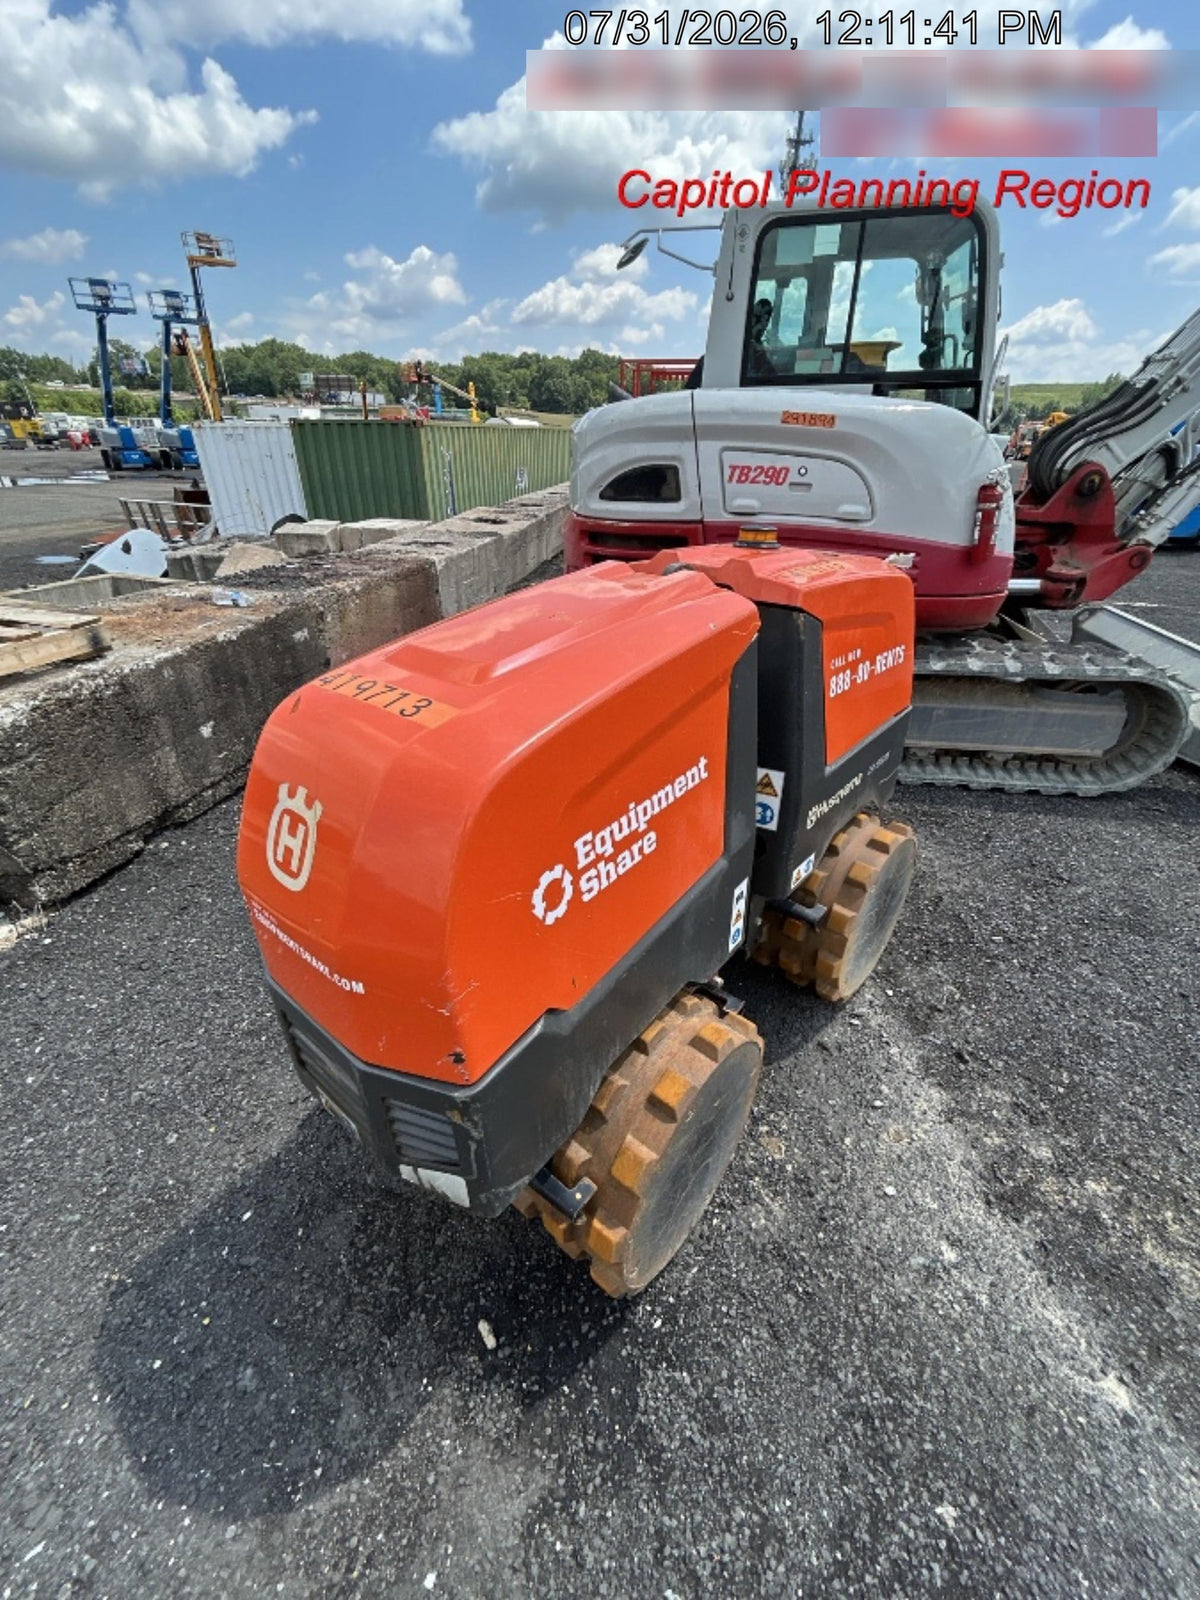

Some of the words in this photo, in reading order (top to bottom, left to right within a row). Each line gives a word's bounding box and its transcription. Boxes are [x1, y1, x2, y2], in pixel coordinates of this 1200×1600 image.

[727, 465, 790, 486] TB290
[573, 755, 708, 870] Equipment
[579, 831, 657, 902] Share
